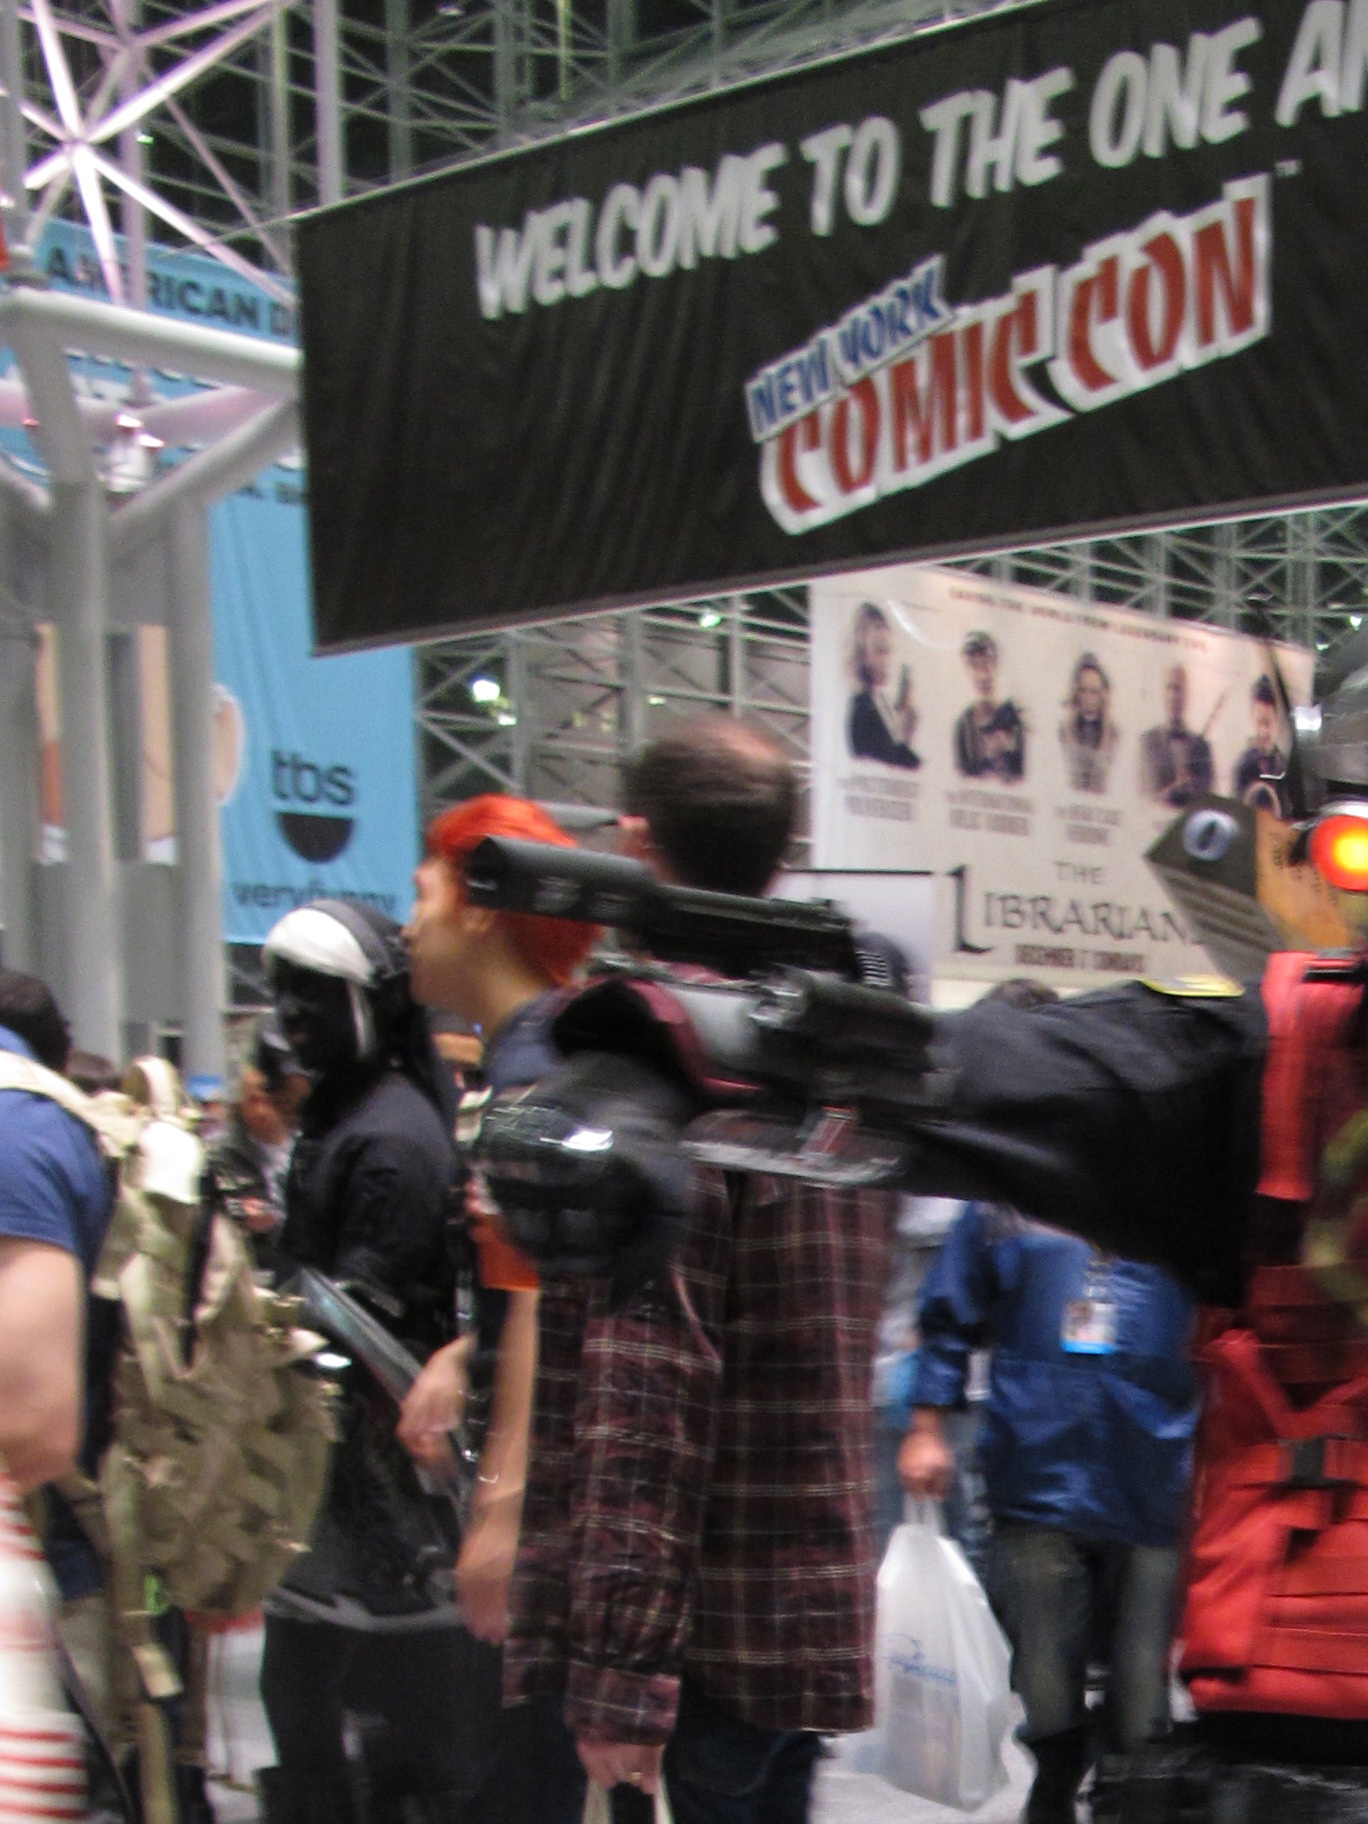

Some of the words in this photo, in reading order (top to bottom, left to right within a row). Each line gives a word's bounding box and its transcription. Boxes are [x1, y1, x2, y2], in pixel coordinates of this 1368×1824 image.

[473, 141, 789, 320] WELCOME
[799, 115, 900, 236] TO
[920, 66, 1074, 208] THE
[1089, 18, 1263, 170] ONE
[751, 335, 833, 431] NEW
[838, 266, 948, 372] YORK
[776, 287, 1039, 515] COMIC
[1066, 196, 1256, 394] CON
[271, 750, 354, 806] tbs
[947, 864, 1206, 955] LIBRARIAN
